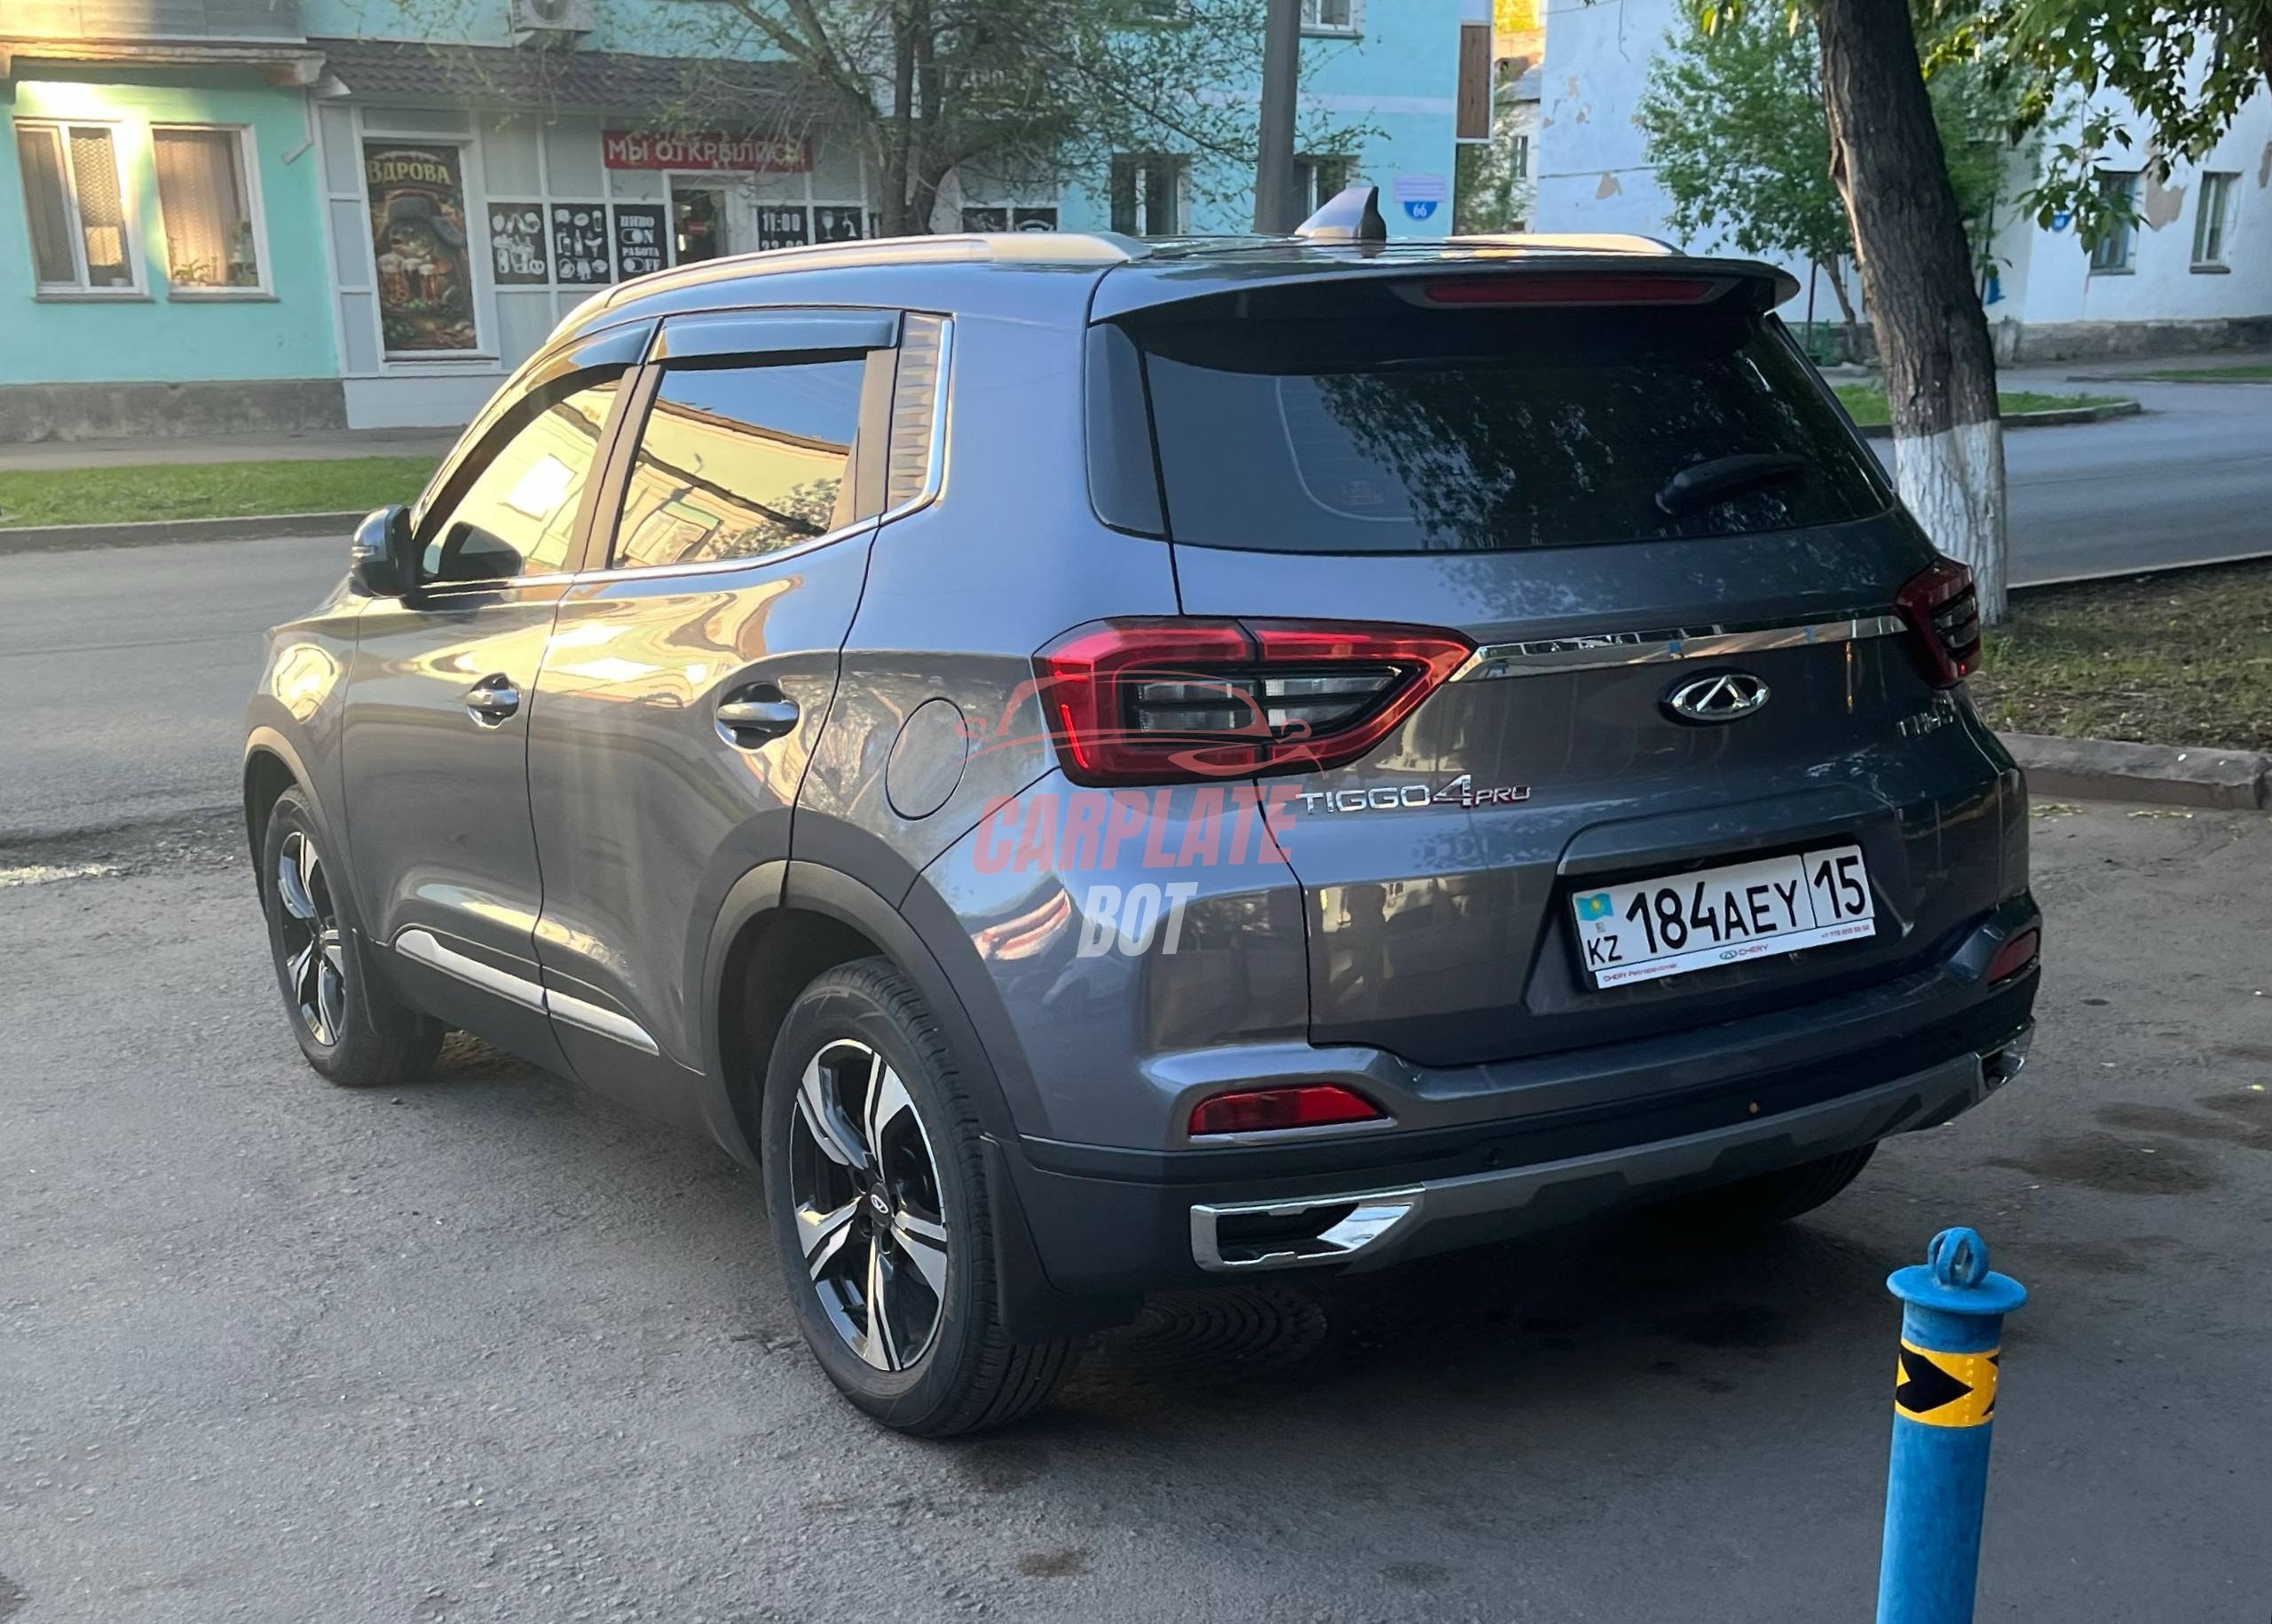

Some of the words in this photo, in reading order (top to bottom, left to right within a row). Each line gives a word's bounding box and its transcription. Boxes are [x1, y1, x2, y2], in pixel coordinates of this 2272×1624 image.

[609, 139, 648, 162] МЫ
[1413, 203, 1427, 217] 66
[622, 247, 660, 257] РАБОТА
[1296, 785, 1430, 814] TIGGO
[1432, 774, 1471, 808] 4
[1474, 785, 1531, 805] PRO
[1626, 879, 1797, 954] 184AEY
[1814, 855, 1866, 918] 15
[1587, 934, 1622, 966] KZ
[1739, 943, 1769, 956] CHERY
